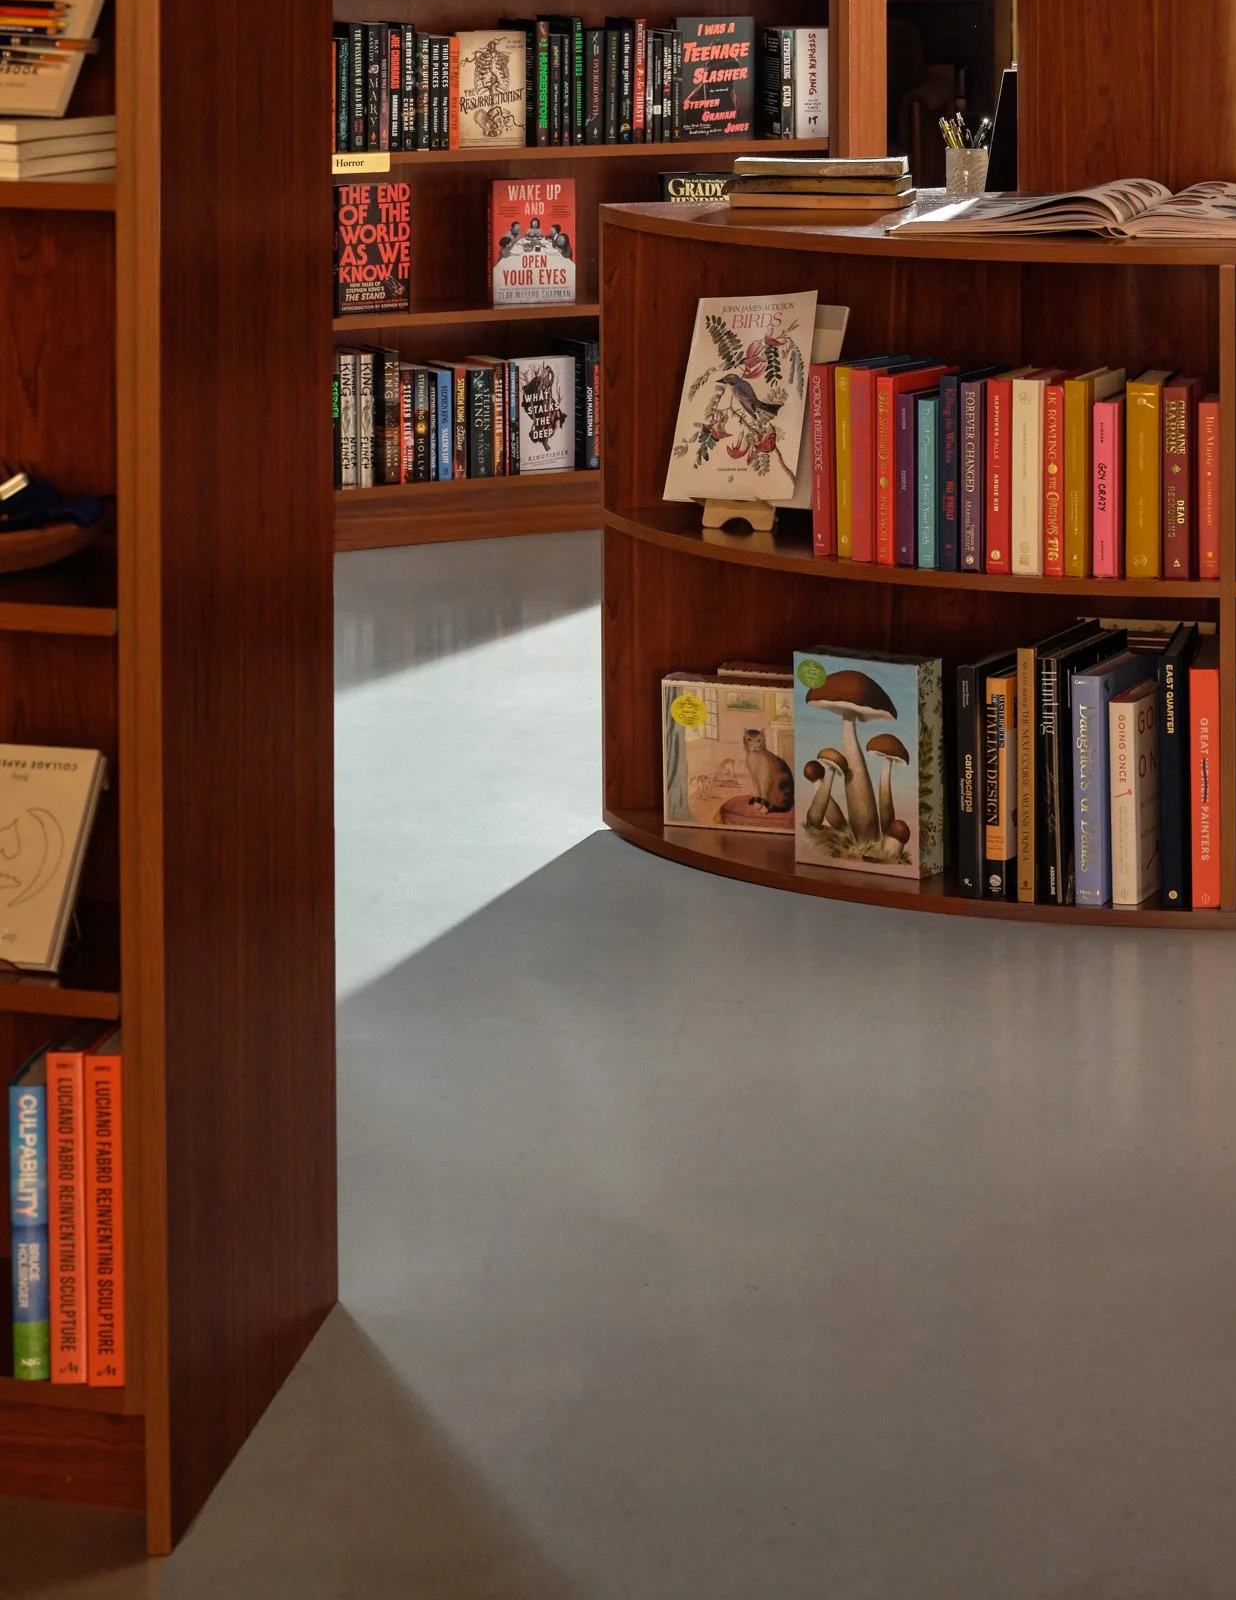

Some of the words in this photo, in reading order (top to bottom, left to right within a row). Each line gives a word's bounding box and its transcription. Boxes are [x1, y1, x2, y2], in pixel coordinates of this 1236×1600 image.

[705, 24, 724, 34] WAS
[728, 22, 735, 33] A
[539, 52, 547, 128] HUNGERSTONE
[336, 158, 364, 167] Horror
[340, 187, 369, 205] THE
[378, 184, 410, 202] END
[508, 185, 541, 200] WAKE
[547, 185, 561, 199] UP
[668, 179, 724, 197] GRADY
[340, 206, 368, 225] OF
[380, 204, 410, 223] THE
[525, 202, 544, 215] AND
[340, 225, 410, 243] WORLD
[341, 246, 368, 266] AS
[379, 244, 410, 262] WE
[522, 255, 547, 268] OPEN
[340, 264, 393, 283] KNOW
[398, 264, 410, 279] IT
[503, 270, 532, 285] YOUR
[539, 269, 566, 284] EYES
[723, 304, 738, 313] JOHN
[740, 303, 761, 312] JAMES
[763, 301, 795, 311] AUDUBON
[732, 312, 782, 330] BIRDS
[524, 392, 549, 402] WHAT
[528, 402, 560, 414] STALKS
[536, 417, 550, 425] THE
[533, 429, 553, 439] DEEP
[1098, 485, 1106, 511] CRAZY
[987, 703, 997, 769] ITALIAN
[987, 771, 997, 825] DESIGN
[57, 1078, 73, 1135] LUCIANO
[17, 1093, 38, 1219] CULPABILITY
[58, 1139, 73, 1181] FABRO
[58, 1185, 75, 1274] REINVENTING
[60, 1278, 76, 1353] SCULPTURE
